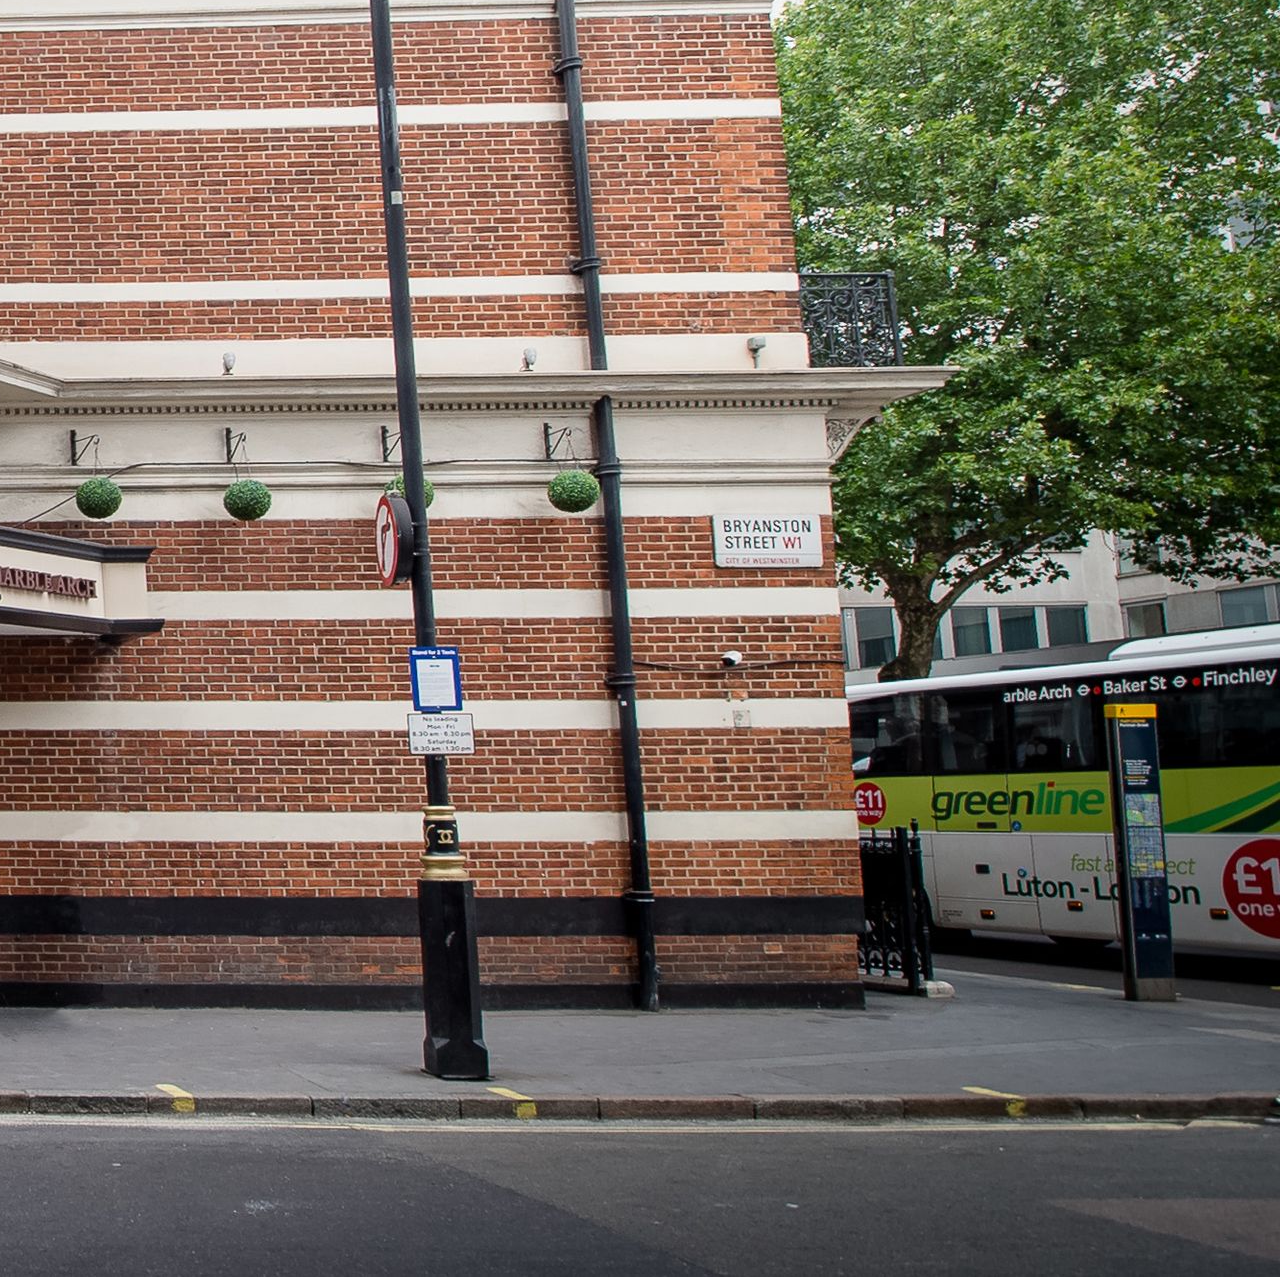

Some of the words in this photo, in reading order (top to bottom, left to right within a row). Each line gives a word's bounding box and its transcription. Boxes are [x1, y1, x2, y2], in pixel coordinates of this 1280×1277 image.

[723, 519, 812, 533] BRYANSTON
[725, 535, 778, 550] STREET
[782, 536, 802, 550] W1
[725, 557, 740, 565] CITY
[742, 557, 751, 565] OF
[752, 557, 800, 565] WESTMINSTER
[54, 575, 98, 599] ARCH
[1103, 678, 1148, 695] Baker
[1149, 675, 1168, 691] St
[1203, 667, 1278, 687] Finchley
[1038, 684, 1072, 700] Arch
[855, 789, 883, 809] £11
[931, 781, 1105, 821] greenline
[1071, 853, 1102, 872] fast
[1001, 873, 1076, 900] Luton
[1237, 902, 1275, 917] one
